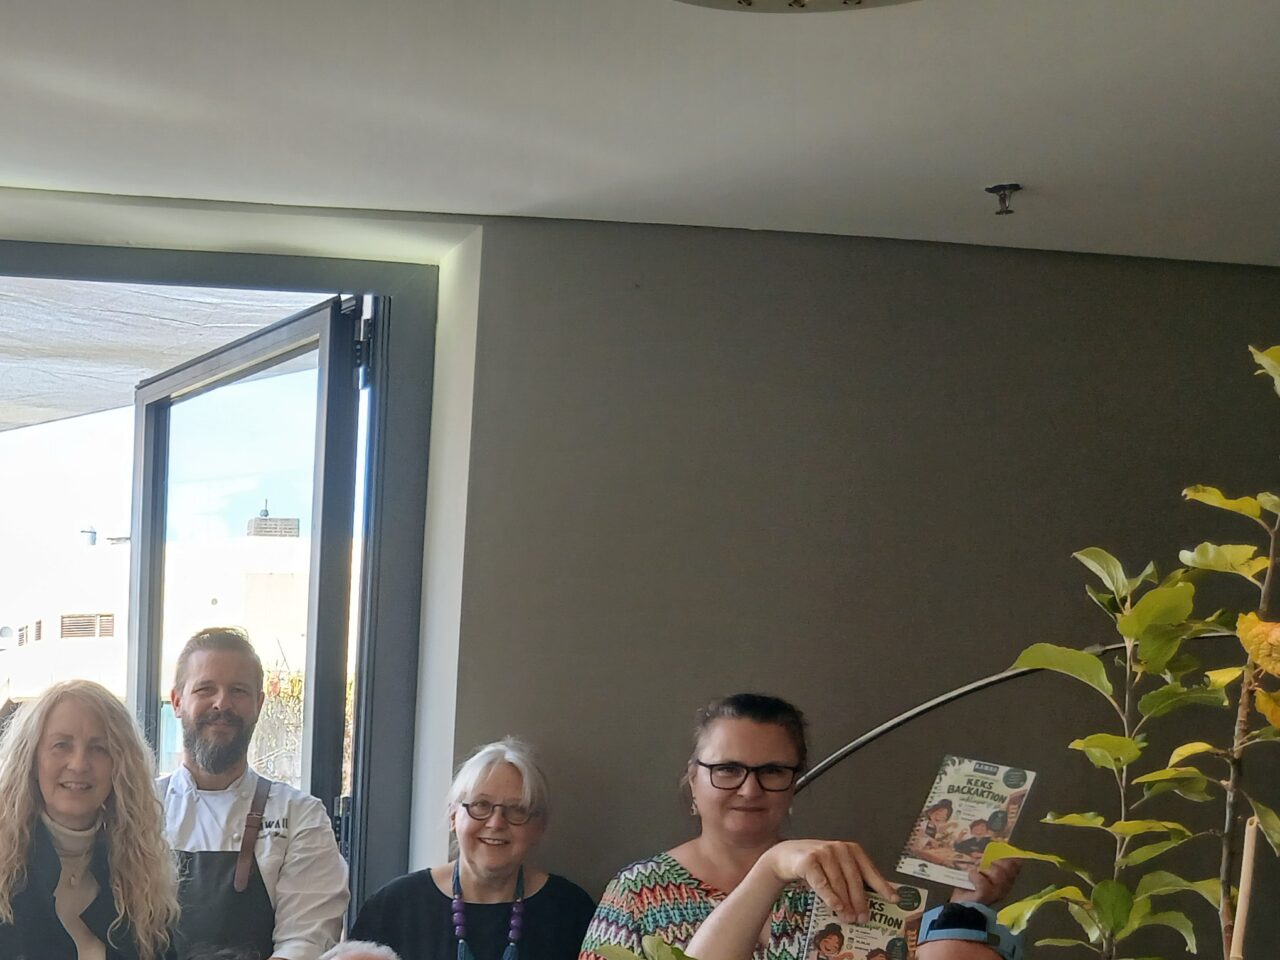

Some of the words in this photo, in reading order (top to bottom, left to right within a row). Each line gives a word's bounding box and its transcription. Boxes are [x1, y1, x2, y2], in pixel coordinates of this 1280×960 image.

[966, 778, 994, 790] KEKS
[947, 784, 1008, 803] BACKAKTION
[869, 900, 885, 912] KS
[870, 911, 903, 930] KTION
